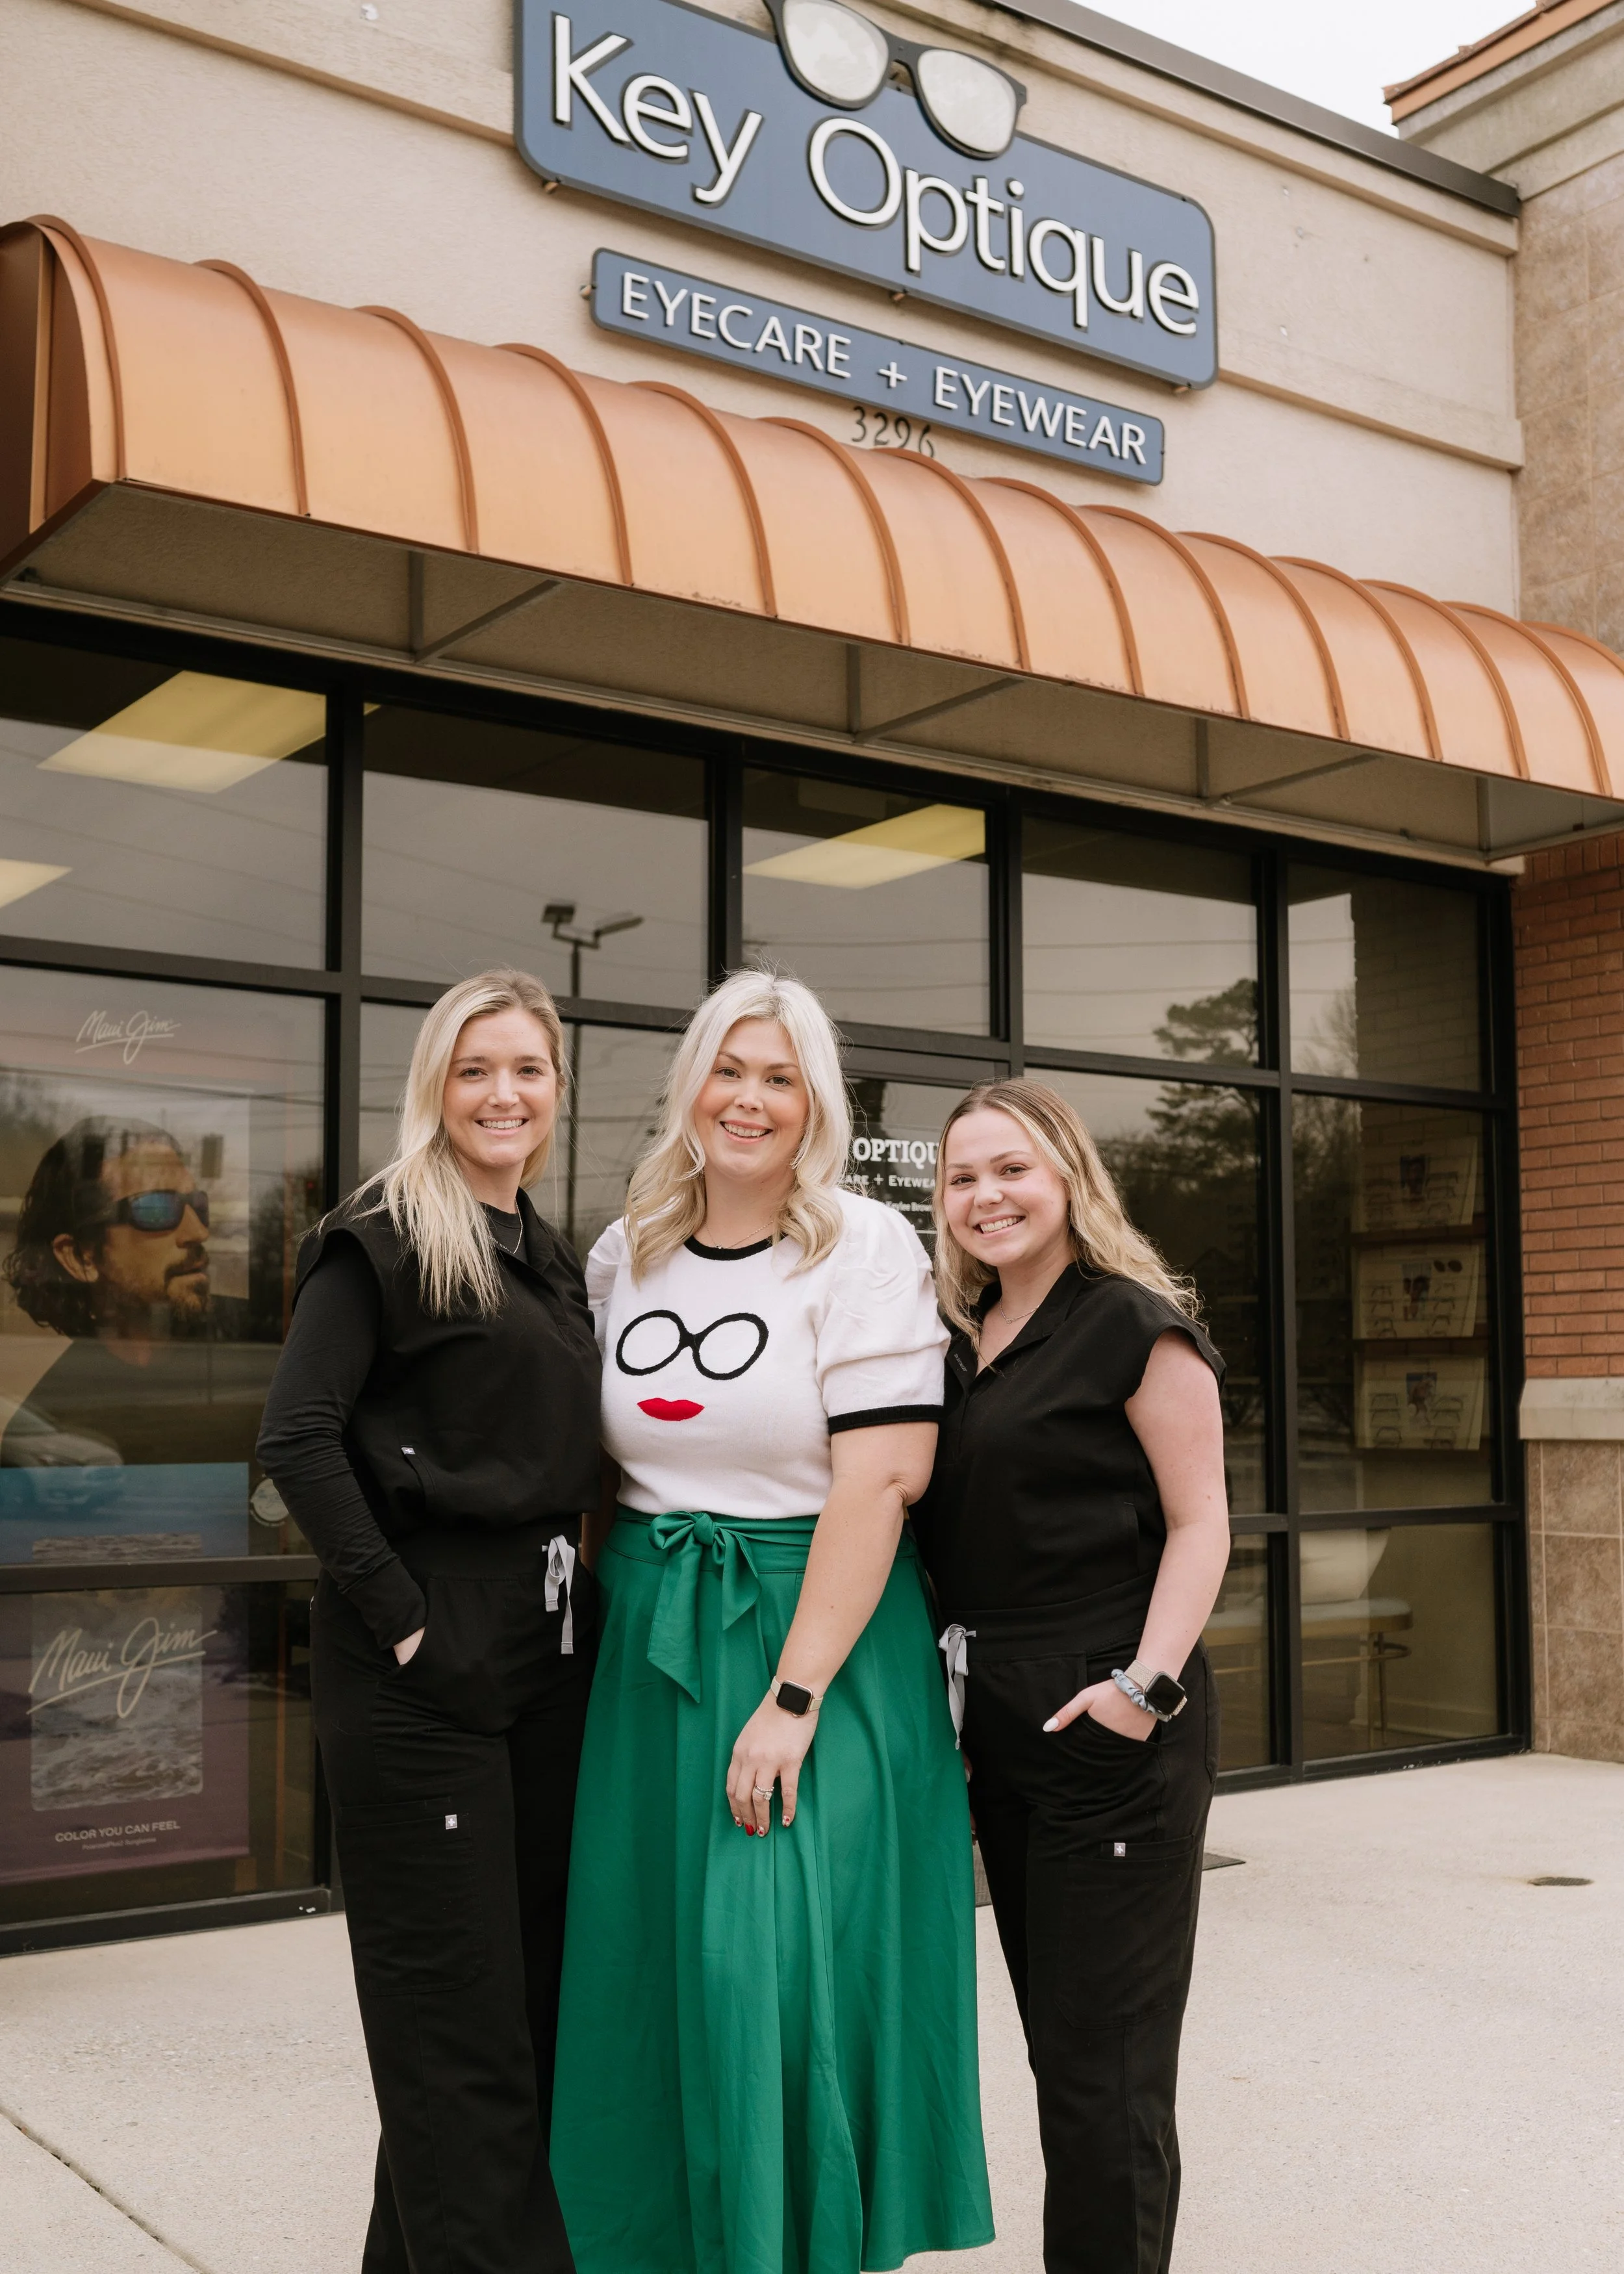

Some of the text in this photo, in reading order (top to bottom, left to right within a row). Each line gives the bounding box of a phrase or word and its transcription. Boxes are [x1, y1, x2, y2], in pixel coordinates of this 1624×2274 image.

[553, 14, 1200, 335] Key Optique
[621, 272, 1147, 465] EYECARE + EYEWEAR
[851, 405, 935, 458] 3296
[75, 1010, 124, 1045] Maui
[852, 1137, 939, 1169] OPTIQU
[841, 1174, 869, 1186] ARE
[888, 1174, 935, 1188] EYEWEA
[28, 1616, 218, 1719] Maui Jim
[55, 1820, 181, 1843] COLOR YOU CAN FEEL
